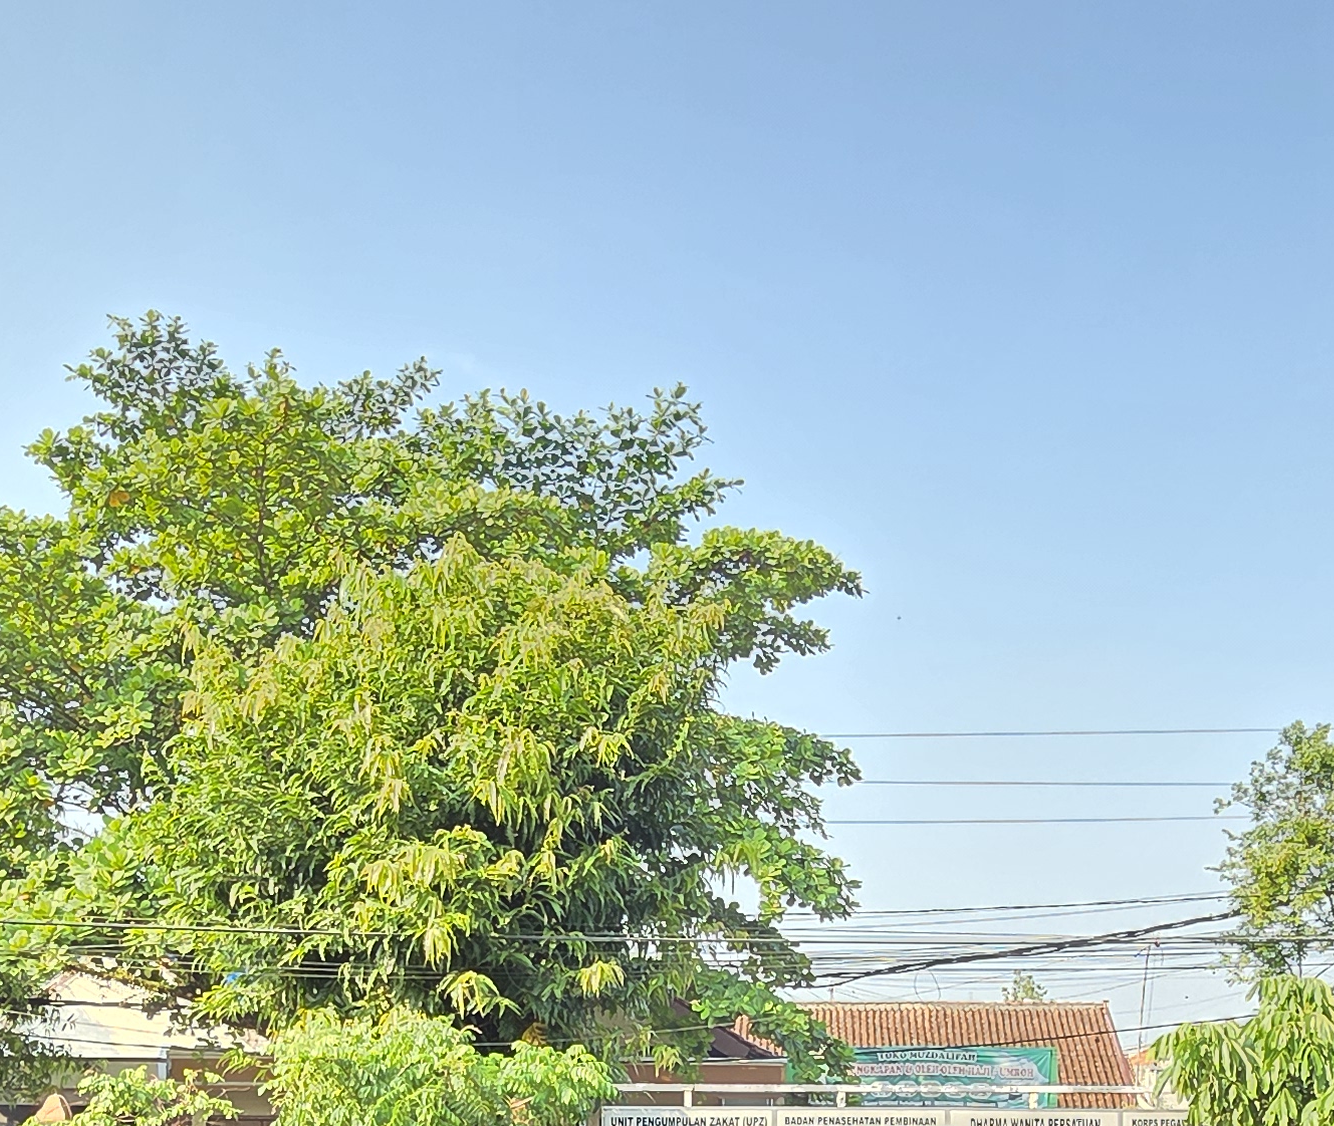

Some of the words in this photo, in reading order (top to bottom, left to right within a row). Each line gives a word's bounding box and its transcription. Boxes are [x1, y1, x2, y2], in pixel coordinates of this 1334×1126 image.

[854, 1064, 902, 1076] NGKAPAN
[611, 1117, 634, 1126] UNIT
[636, 1117, 707, 1126] PENGUMPULAN
[709, 1117, 740, 1126] ZAKAT
[784, 1117, 815, 1125] BADAN
[817, 1117, 882, 1125] PENASEHATAN
[884, 1117, 937, 1126] PEMBINAAN
